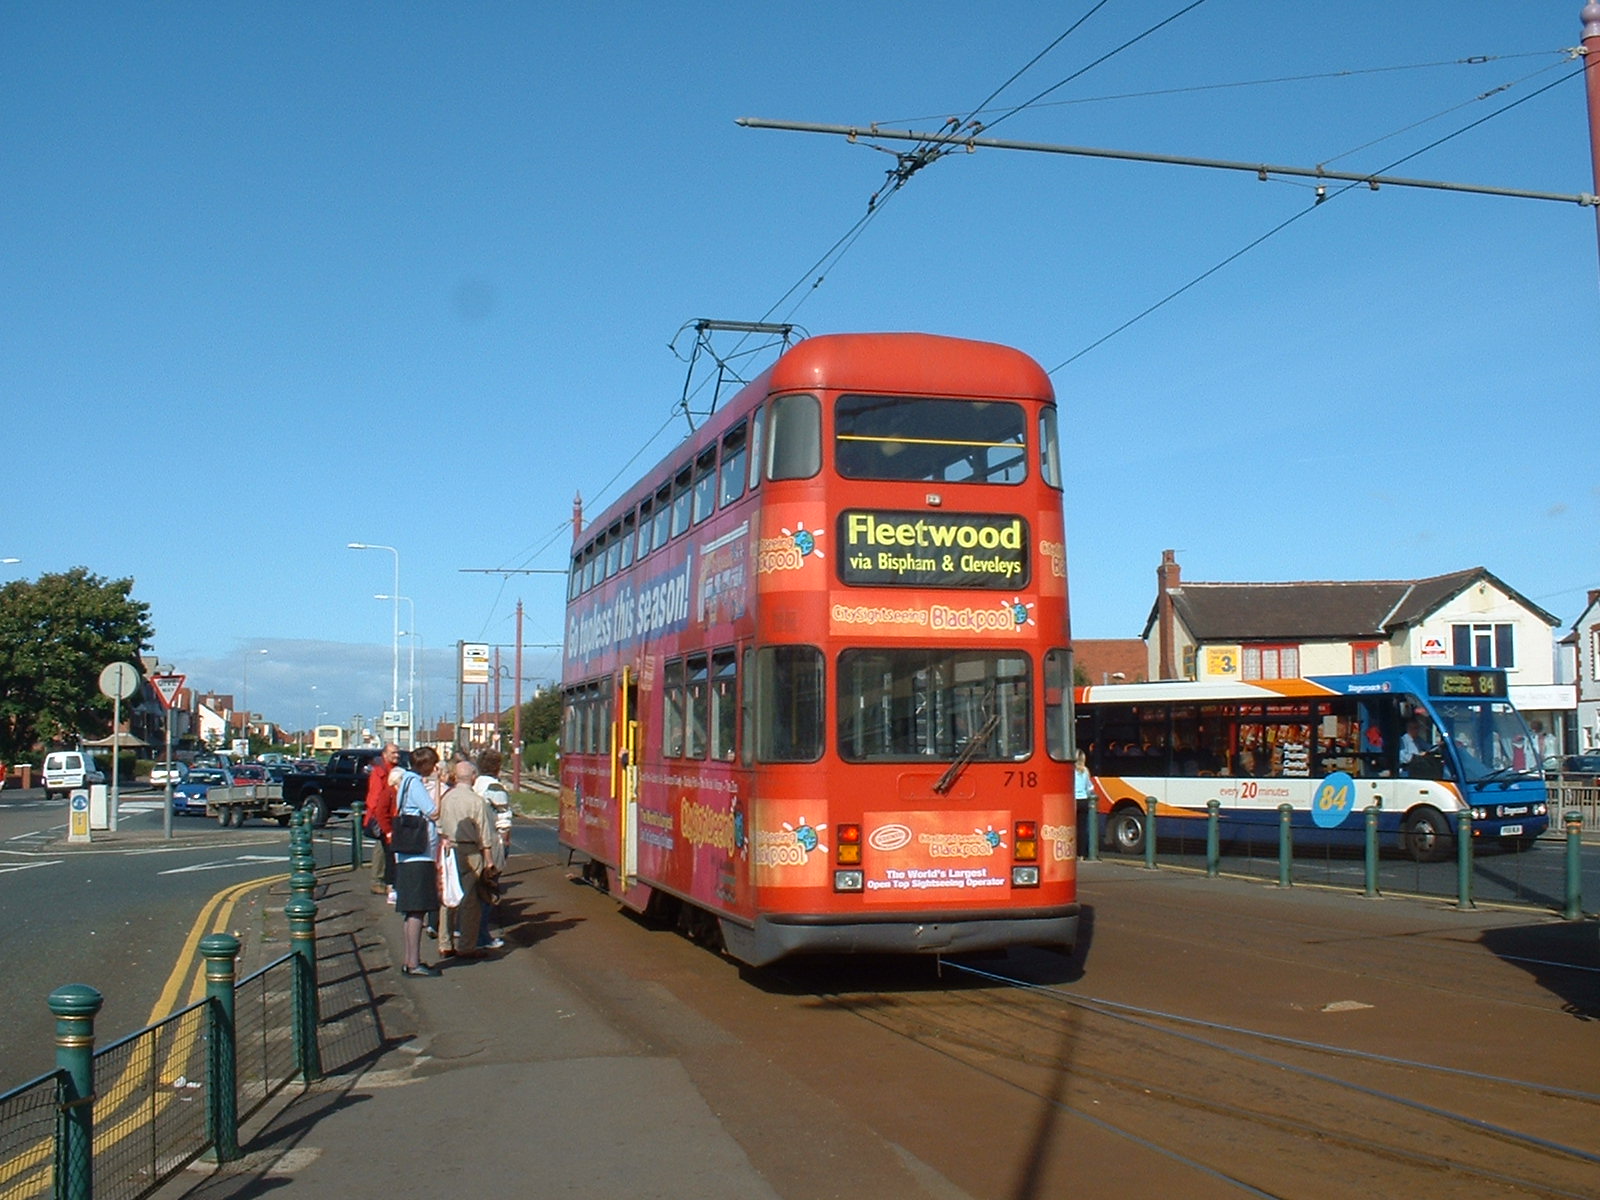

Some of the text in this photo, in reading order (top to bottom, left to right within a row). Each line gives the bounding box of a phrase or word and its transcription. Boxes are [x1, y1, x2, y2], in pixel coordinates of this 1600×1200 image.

[848, 515, 1021, 549] Fleetwood
[850, 553, 1021, 578] via Bispham & Cleveleys
[568, 554, 691, 664] Go topless this season!
[929, 604, 1015, 633] Blackpool
[1478, 676, 1495, 694] 84
[1004, 771, 1038, 788] 718
[1219, 782, 1290, 798] every 20 minutes
[1319, 785, 1349, 811] 84
[929, 843, 993, 858] Blackpool
[886, 868, 987, 880] The World's Largest
[867, 877, 1005, 890] Open Top Sightseeing Operator
